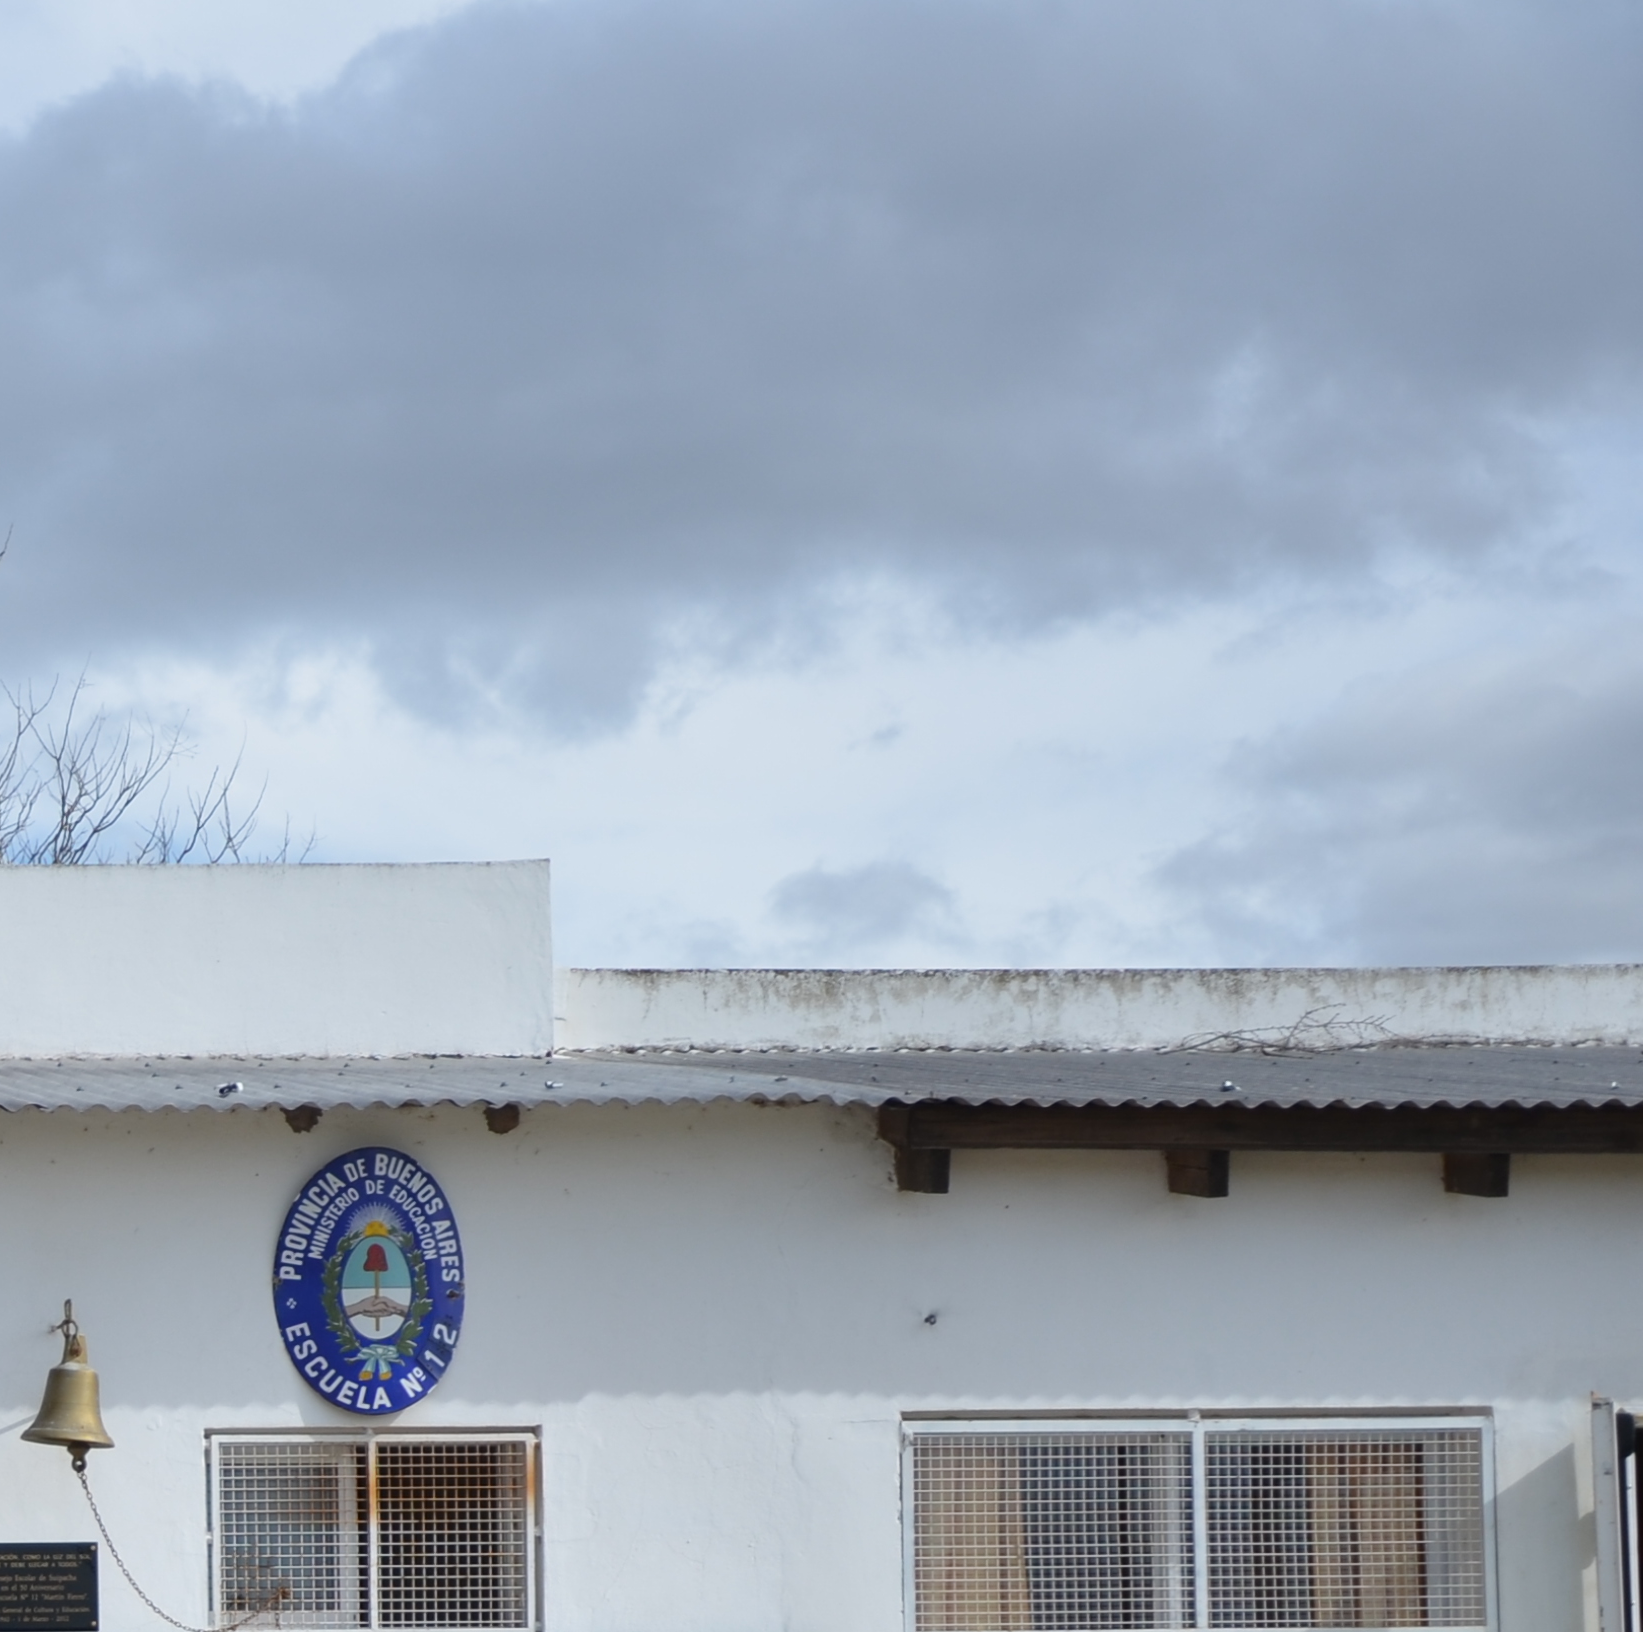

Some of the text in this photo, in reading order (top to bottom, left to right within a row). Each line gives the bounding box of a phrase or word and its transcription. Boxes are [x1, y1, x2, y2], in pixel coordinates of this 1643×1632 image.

[279, 1153, 460, 1283] PROVINCIA DE BUENOS AIRES
[307, 1179, 438, 1261] MINISTERIO DE EDUCACION
[285, 1322, 392, 1410] ESCUELA
[424, 1322, 458, 1369] 12
[15, 1574, 36, 1582] Escolar
[48, 1574, 77, 1583] Suipacha
[30, 1583, 65, 1591] Aniversario
